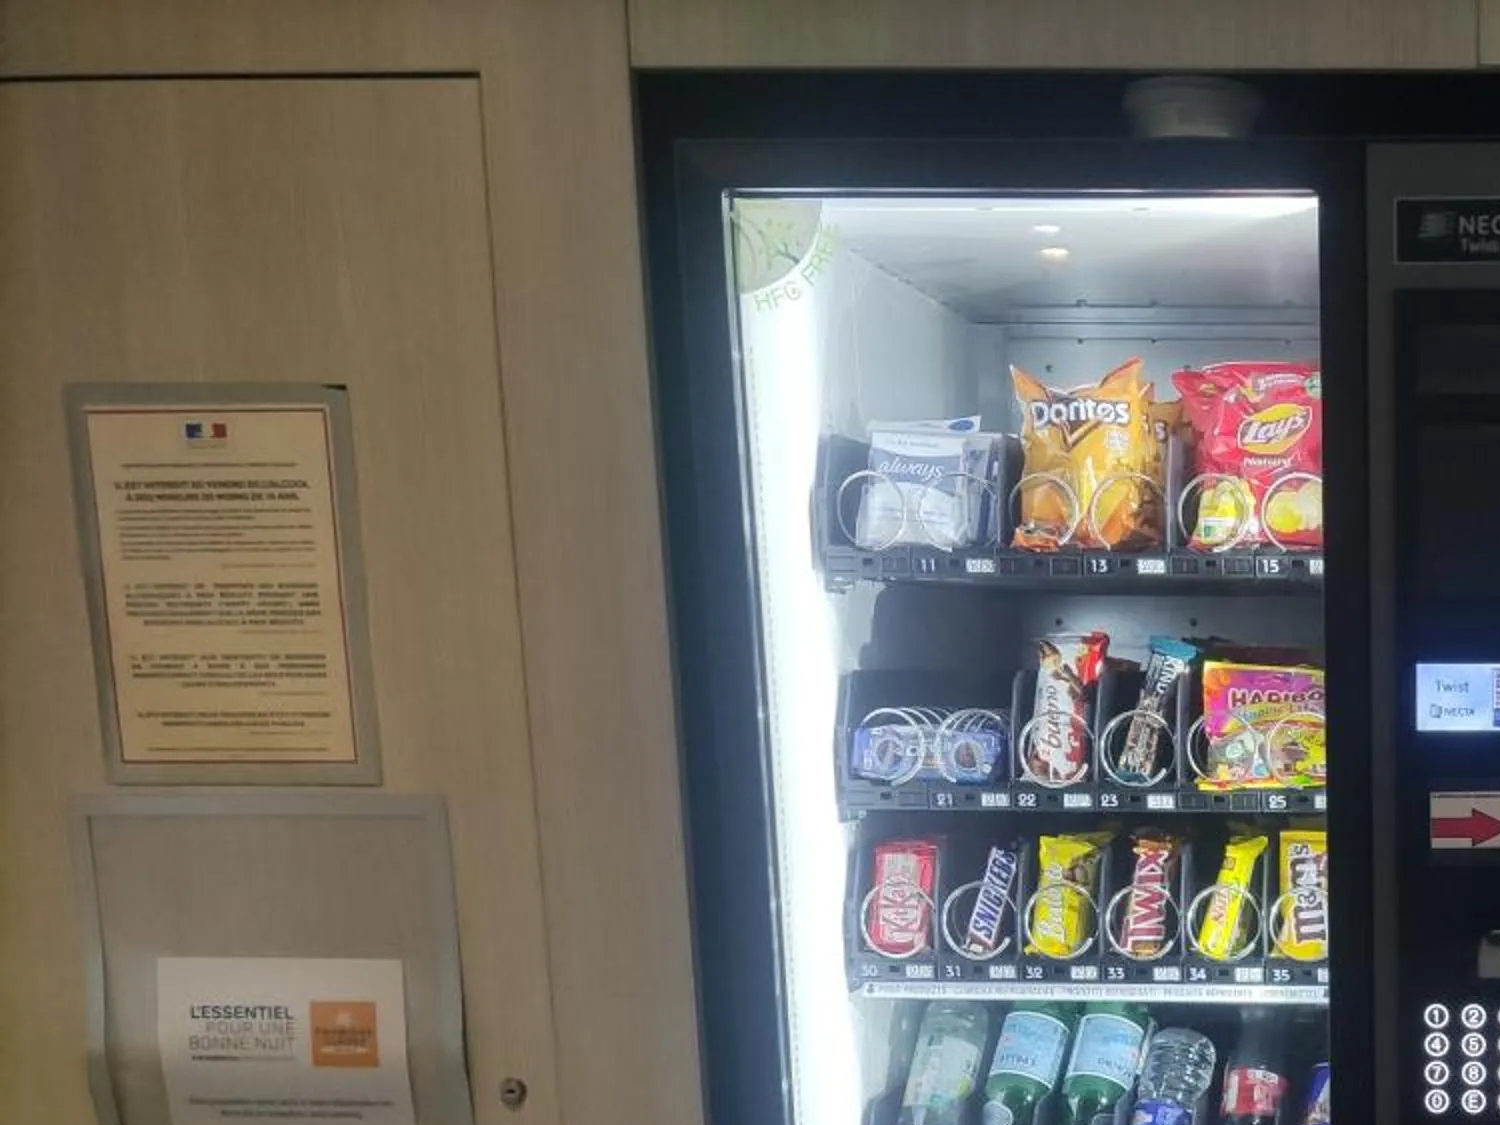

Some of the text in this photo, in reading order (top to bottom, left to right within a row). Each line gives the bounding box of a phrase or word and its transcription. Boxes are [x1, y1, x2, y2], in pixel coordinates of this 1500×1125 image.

[1031, 398, 1130, 428] Doritos
[879, 456, 946, 483] always
[921, 558, 936, 574] 11
[1091, 559, 1108, 574] 13
[1262, 559, 1281, 574] 15
[1434, 679, 1470, 693] Twist
[1041, 684, 1062, 749] bueno
[1018, 793, 1037, 807] 22
[1101, 794, 1119, 808] 23
[1268, 795, 1288, 809] 25
[1121, 850, 1169, 951] TWIX
[945, 965, 962, 978] 31
[1025, 965, 1044, 979] 32
[1107, 967, 1126, 981] 33
[1189, 968, 1208, 982] 34
[1271, 969, 1290, 983] 35
[190, 1005, 295, 1021] L'ESSENTIEL
[1433, 1009, 1441, 1023] 1
[1469, 1010, 1479, 1023] 2
[1468, 1038, 1479, 1051] 5
[1431, 1066, 1442, 1080] 7
[1468, 1066, 1479, 1080] 8
[1431, 1094, 1442, 1108] 0
[1468, 1094, 1479, 1108] E
